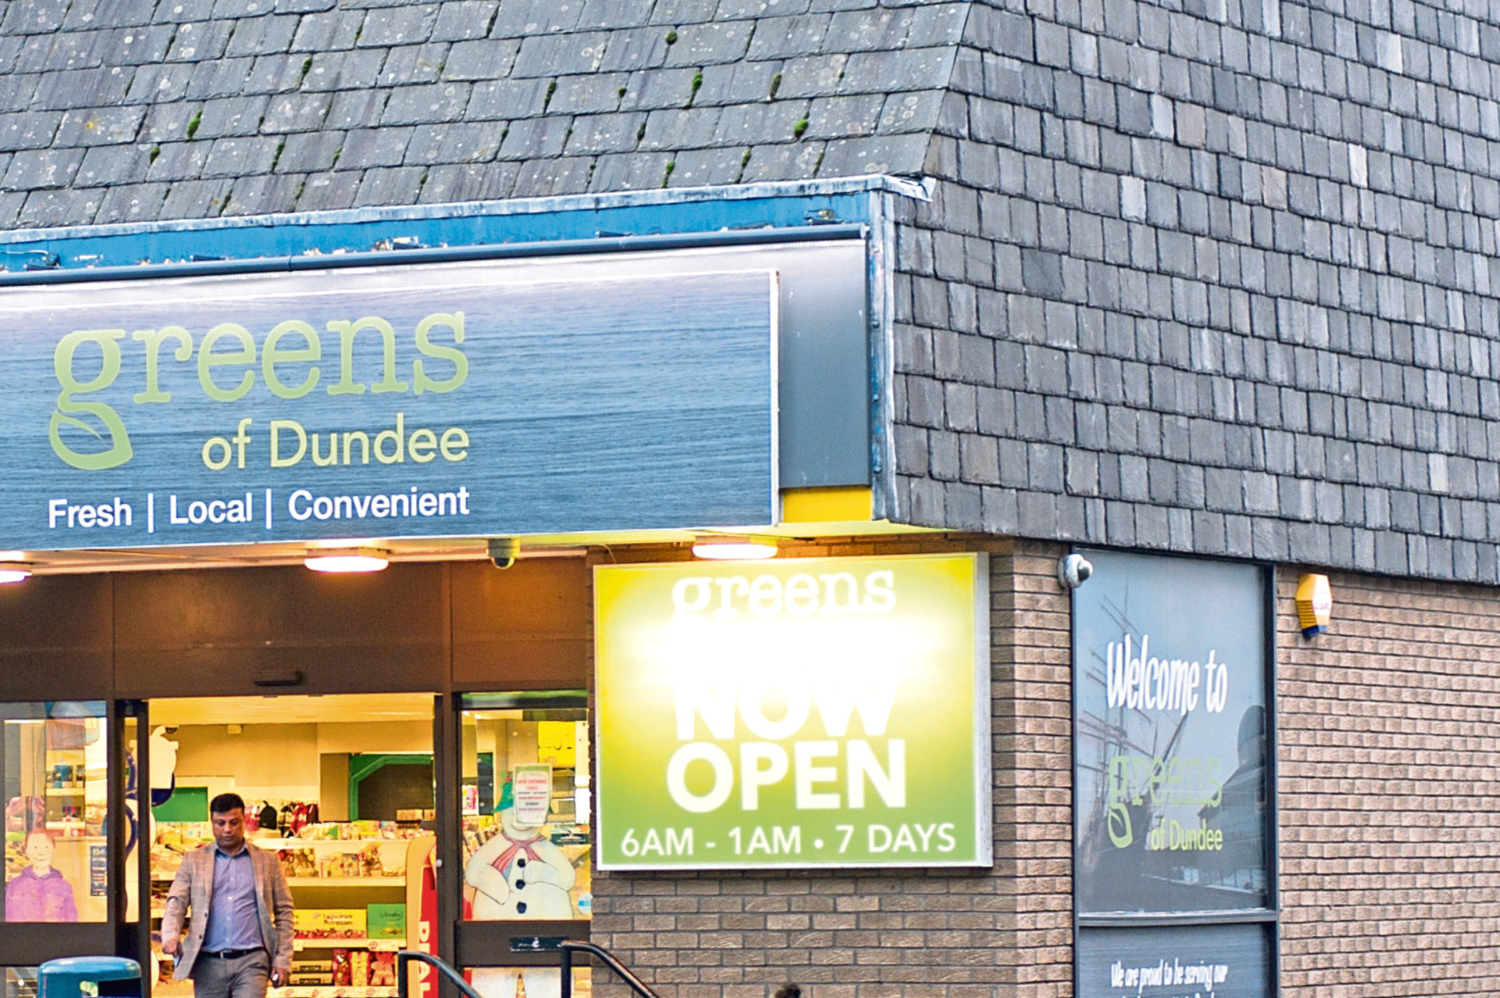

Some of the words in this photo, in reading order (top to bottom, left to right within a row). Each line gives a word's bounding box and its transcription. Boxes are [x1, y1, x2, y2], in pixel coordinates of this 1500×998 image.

[49, 311, 470, 471] greens
[202, 417, 253, 471] of
[270, 412, 470, 468] Dundee
[48, 497, 133, 529] Fresh
[169, 492, 253, 525] Local
[288, 486, 470, 521] Convenient
[672, 569, 897, 620] greens
[1107, 633, 1201, 716] Welcome
[1205, 649, 1229, 714] to
[674, 669, 900, 740] NOW
[665, 739, 907, 813] OPEN
[1107, 755, 1223, 849] greens
[620, 828, 695, 857] 6AM
[728, 826, 802, 855] 1AM
[835, 825, 855, 853] 7
[867, 823, 957, 852] DAYS
[1150, 818, 1165, 850] of
[1169, 818, 1223, 851] Dundee
[1110, 959, 1124, 988] We
[1125, 967, 1139, 987] are
[1139, 958, 1163, 995] proud
[1163, 961, 1173, 986] to
[1173, 957, 1184, 985] be
[1184, 959, 1213, 992] serving
[1213, 963, 1229, 984] our
